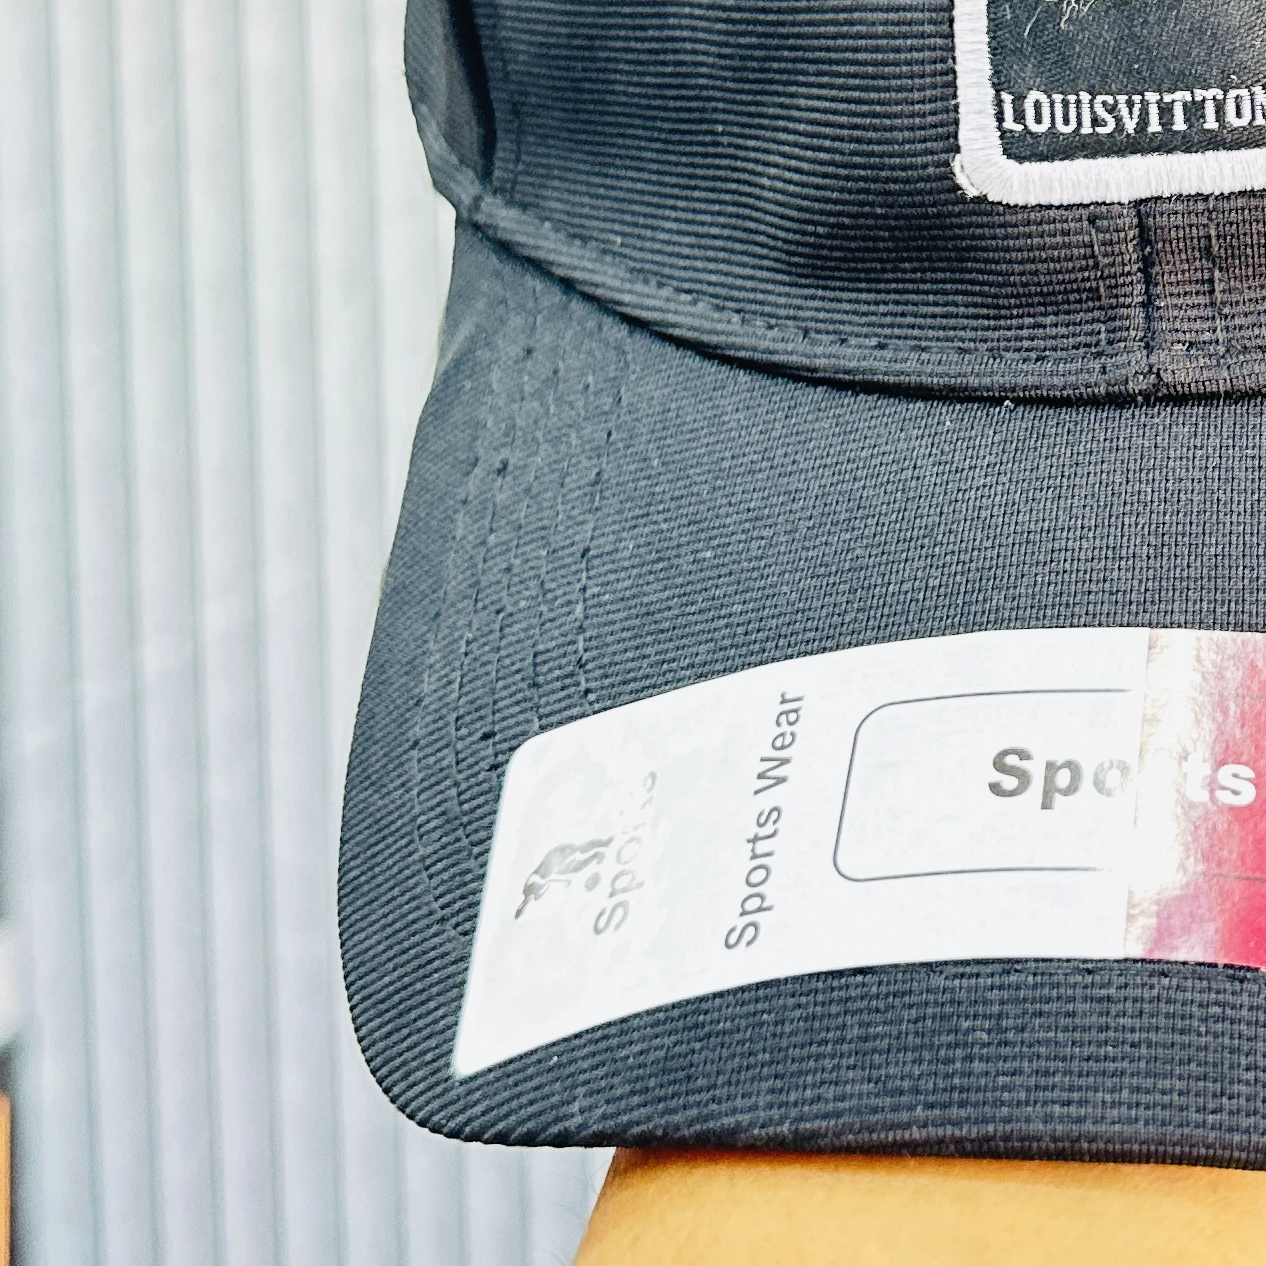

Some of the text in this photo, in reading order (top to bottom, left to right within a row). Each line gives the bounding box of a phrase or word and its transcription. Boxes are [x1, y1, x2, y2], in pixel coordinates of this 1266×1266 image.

[594, 771, 658, 937] Spors
[724, 691, 805, 951] Sports Wear
[988, 746, 1257, 810] Spots
